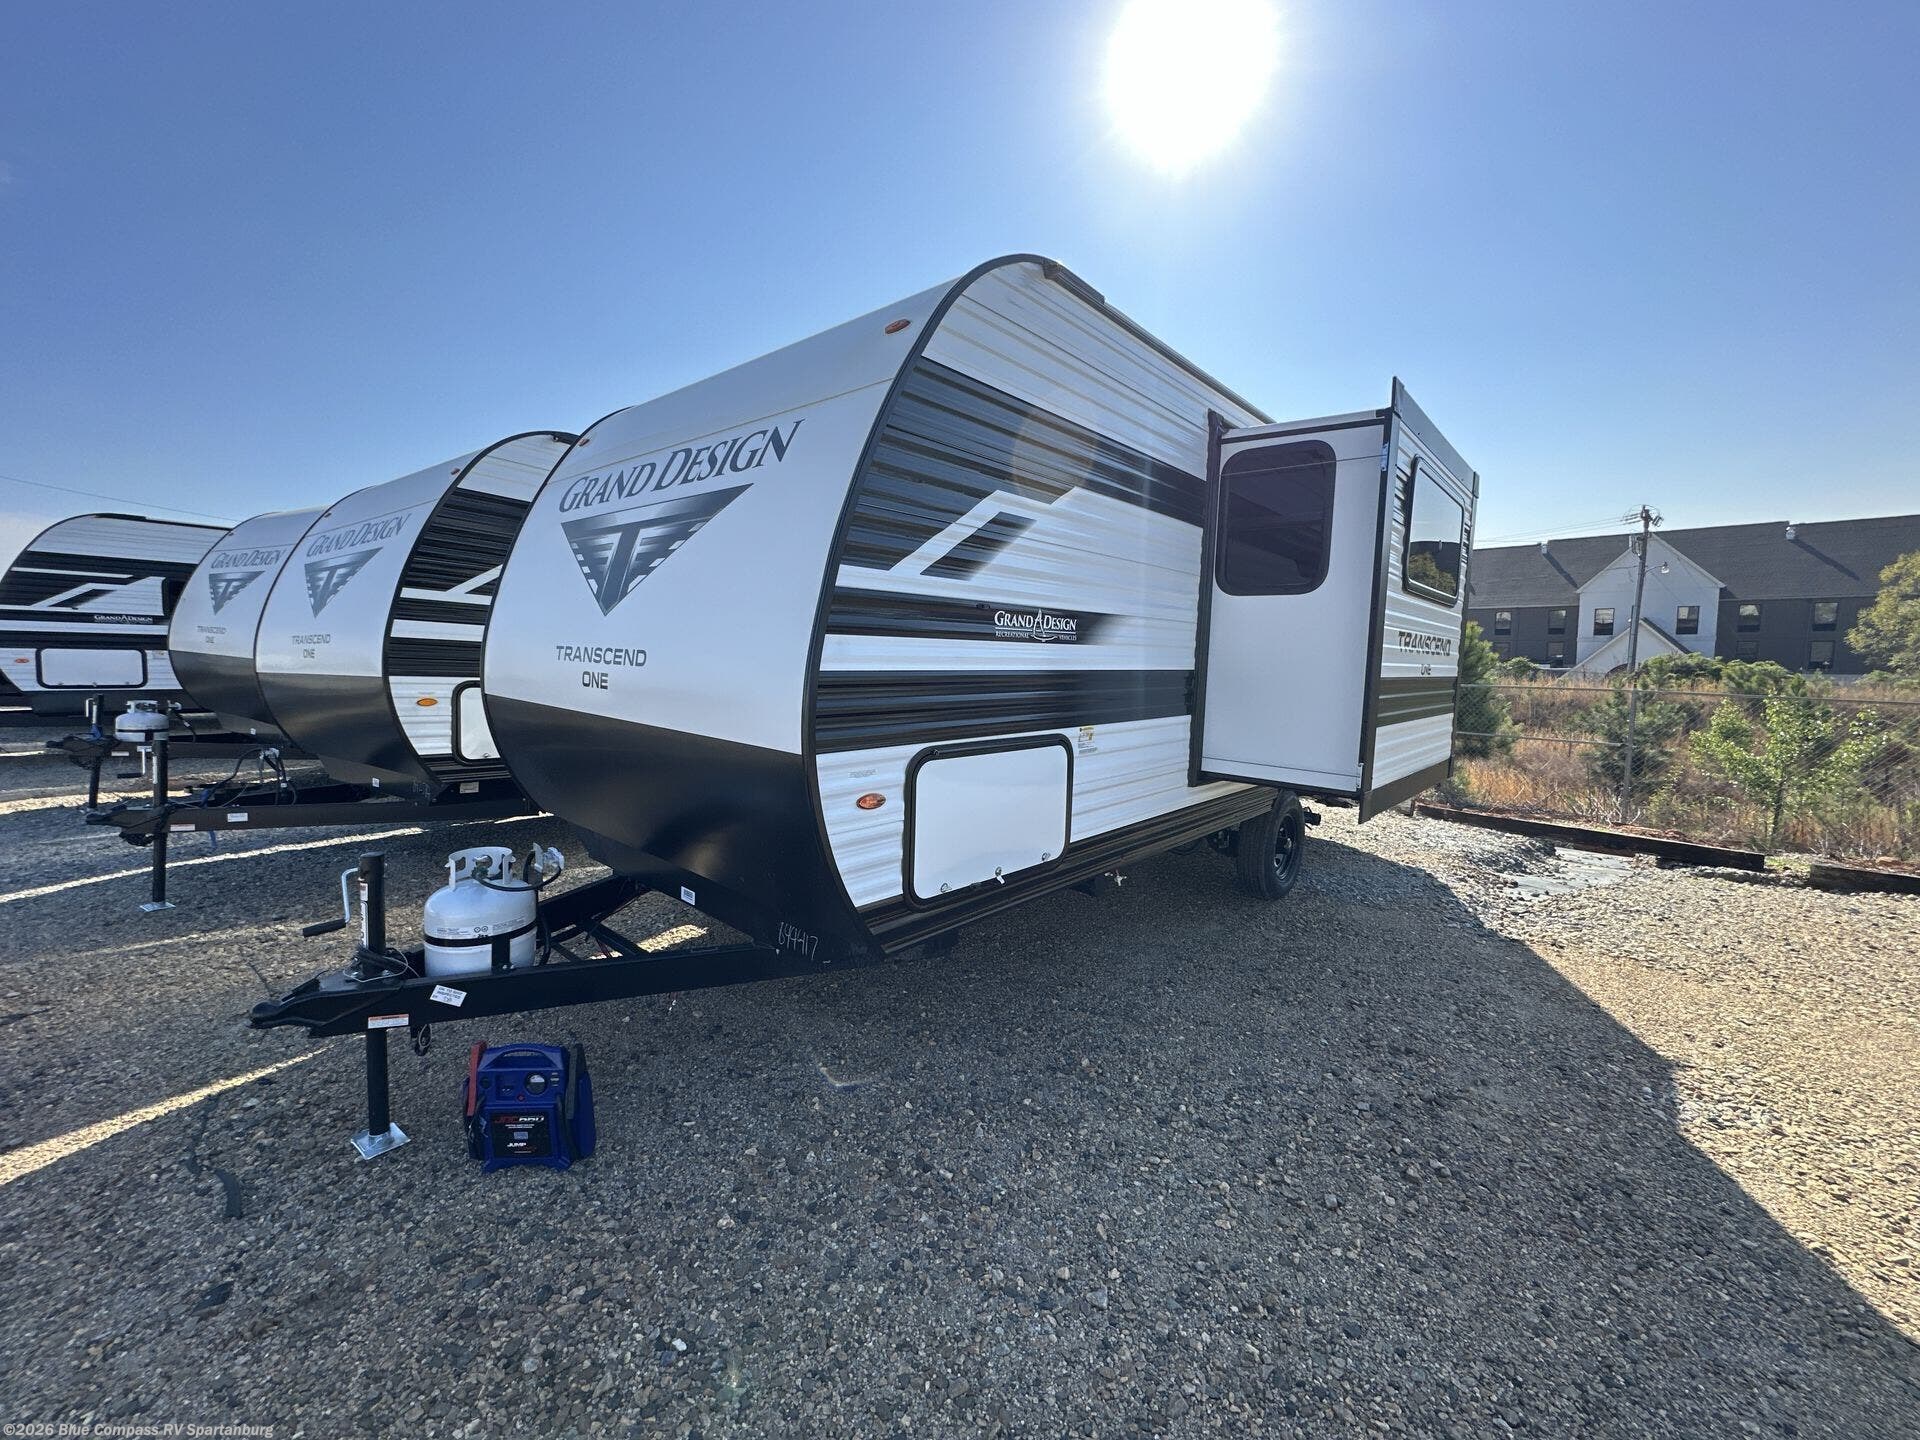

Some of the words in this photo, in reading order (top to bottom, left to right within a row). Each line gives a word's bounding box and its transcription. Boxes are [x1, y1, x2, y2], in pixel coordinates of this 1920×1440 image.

[558, 462, 656, 513] GRAND
[651, 418, 805, 492] DESIGN
[306, 529, 356, 557] GRAND
[355, 512, 412, 545] DESIGN
[211, 552, 245, 569] GRAND
[243, 549, 287, 567] DESIGN
[197, 625, 227, 635] TRANSCEND
[994, 610, 1034, 628] GRAND
[1043, 615, 1077, 631] DESIGN
[291, 634, 331, 646] TRANSCEND
[1398, 631, 1451, 656] TRANSCEND
[302, 648, 315, 659] ONE
[556, 645, 647, 667] TRANSCEND
[581, 670, 609, 690] ONE
